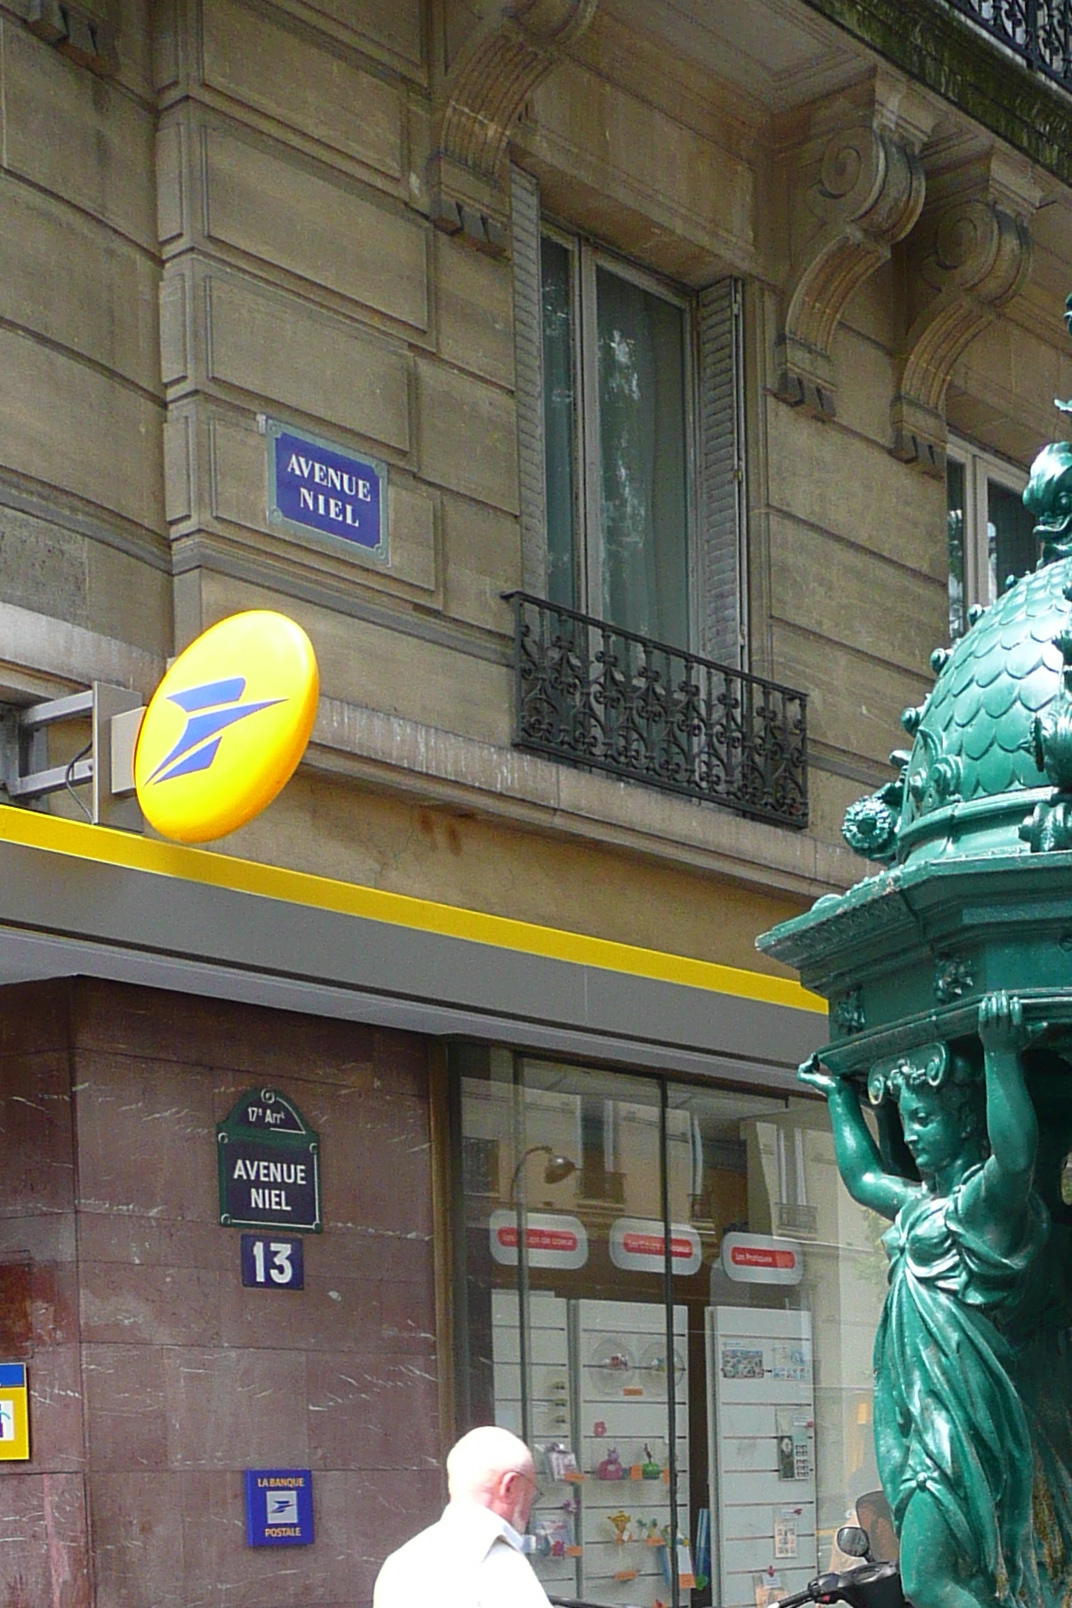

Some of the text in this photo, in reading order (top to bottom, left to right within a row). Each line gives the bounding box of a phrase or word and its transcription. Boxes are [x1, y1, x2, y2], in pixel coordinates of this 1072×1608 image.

[287, 453, 371, 502] AVENUE
[300, 487, 359, 527] NIEL
[233, 1159, 307, 1185] AVENUE
[250, 1188, 292, 1211] NIEL
[253, 1241, 293, 1283] 13
[257, 1477, 305, 1488] LA BANQUE
[264, 1527, 302, 1538] POSTALE
